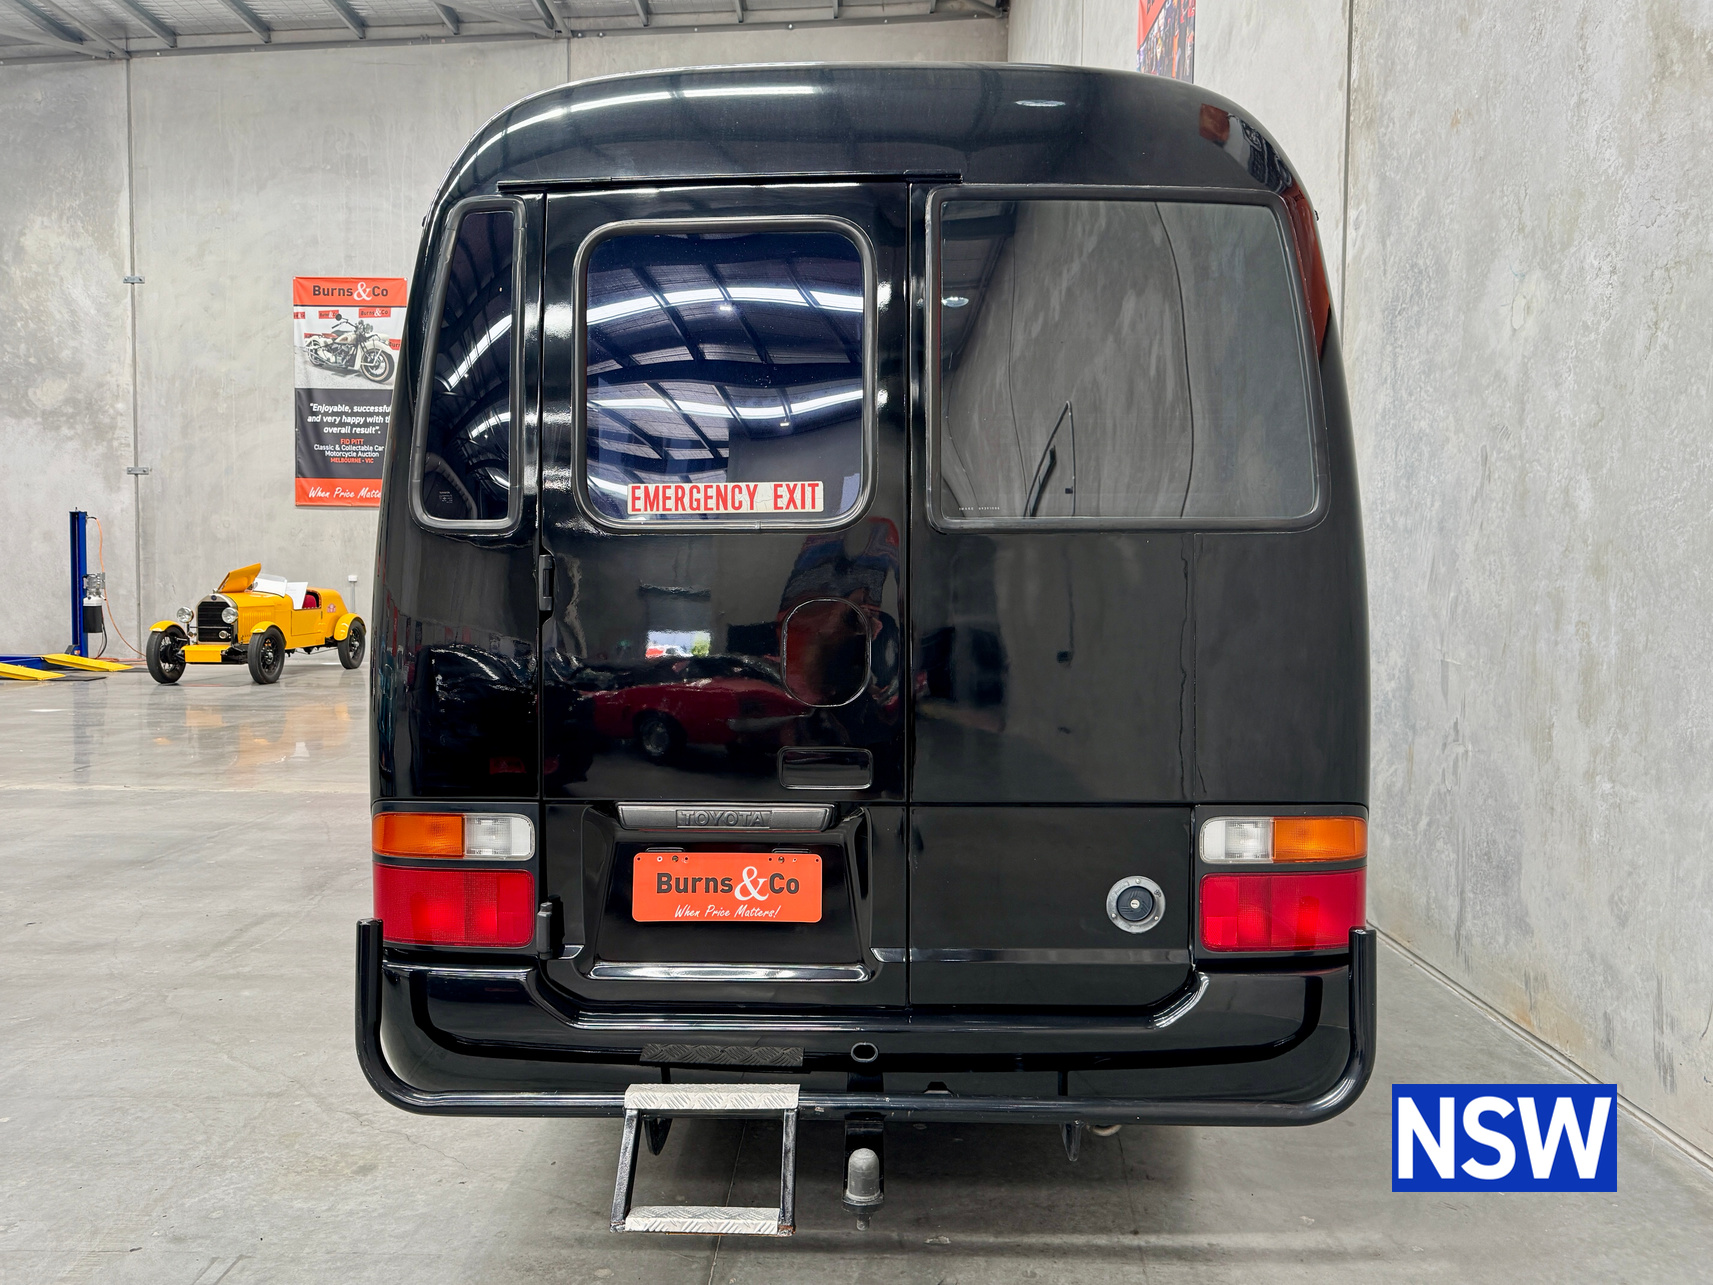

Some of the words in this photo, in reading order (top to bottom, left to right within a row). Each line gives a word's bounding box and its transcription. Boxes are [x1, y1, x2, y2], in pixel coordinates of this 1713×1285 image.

[313, 282, 388, 301] Burns&Co
[360, 308, 388, 316] Burns&Co
[341, 415, 365, 424] happy
[308, 486, 330, 498] When
[333, 487, 355, 498] Price
[630, 484, 758, 512] EMERGENCY
[773, 483, 820, 511] EXIT
[680, 810, 765, 826] TOYOTA
[656, 866, 800, 901] Burns&Co
[674, 904, 700, 918] When
[704, 905, 731, 918] Price
[734, 905, 781, 918] Matters!
